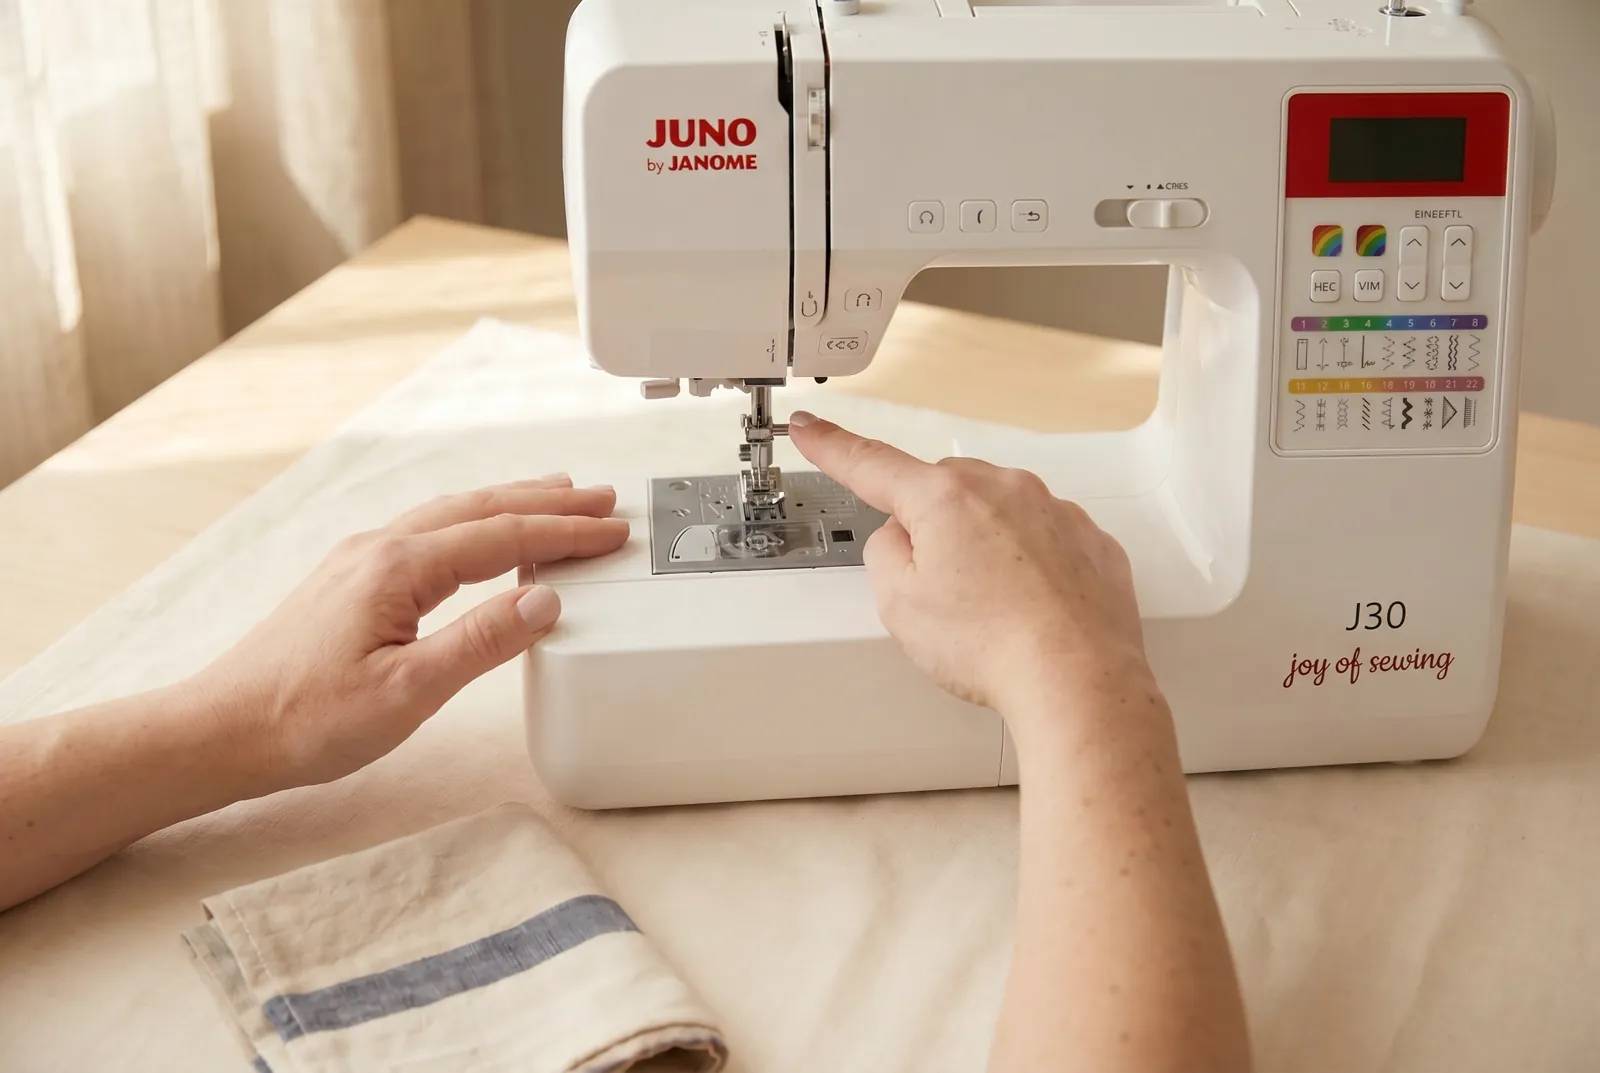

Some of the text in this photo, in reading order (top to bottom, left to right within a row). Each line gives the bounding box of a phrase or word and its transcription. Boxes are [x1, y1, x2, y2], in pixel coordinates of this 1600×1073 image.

[646, 118, 757, 148] JUNO
[647, 154, 758, 175] by JANOME
[1314, 281, 1336, 291] HEC
[1359, 281, 1381, 291] VIM
[1301, 318, 1479, 329] 1 2 3 4 4 5 6 7 8
[1361, 381, 1372, 390] 16
[1382, 380, 1394, 389] 18
[1404, 380, 1415, 389] 19
[1445, 380, 1456, 389] 21
[1466, 380, 1478, 389] 22
[1345, 600, 1407, 631] J30
[1282, 646, 1455, 689] joy of sewing
